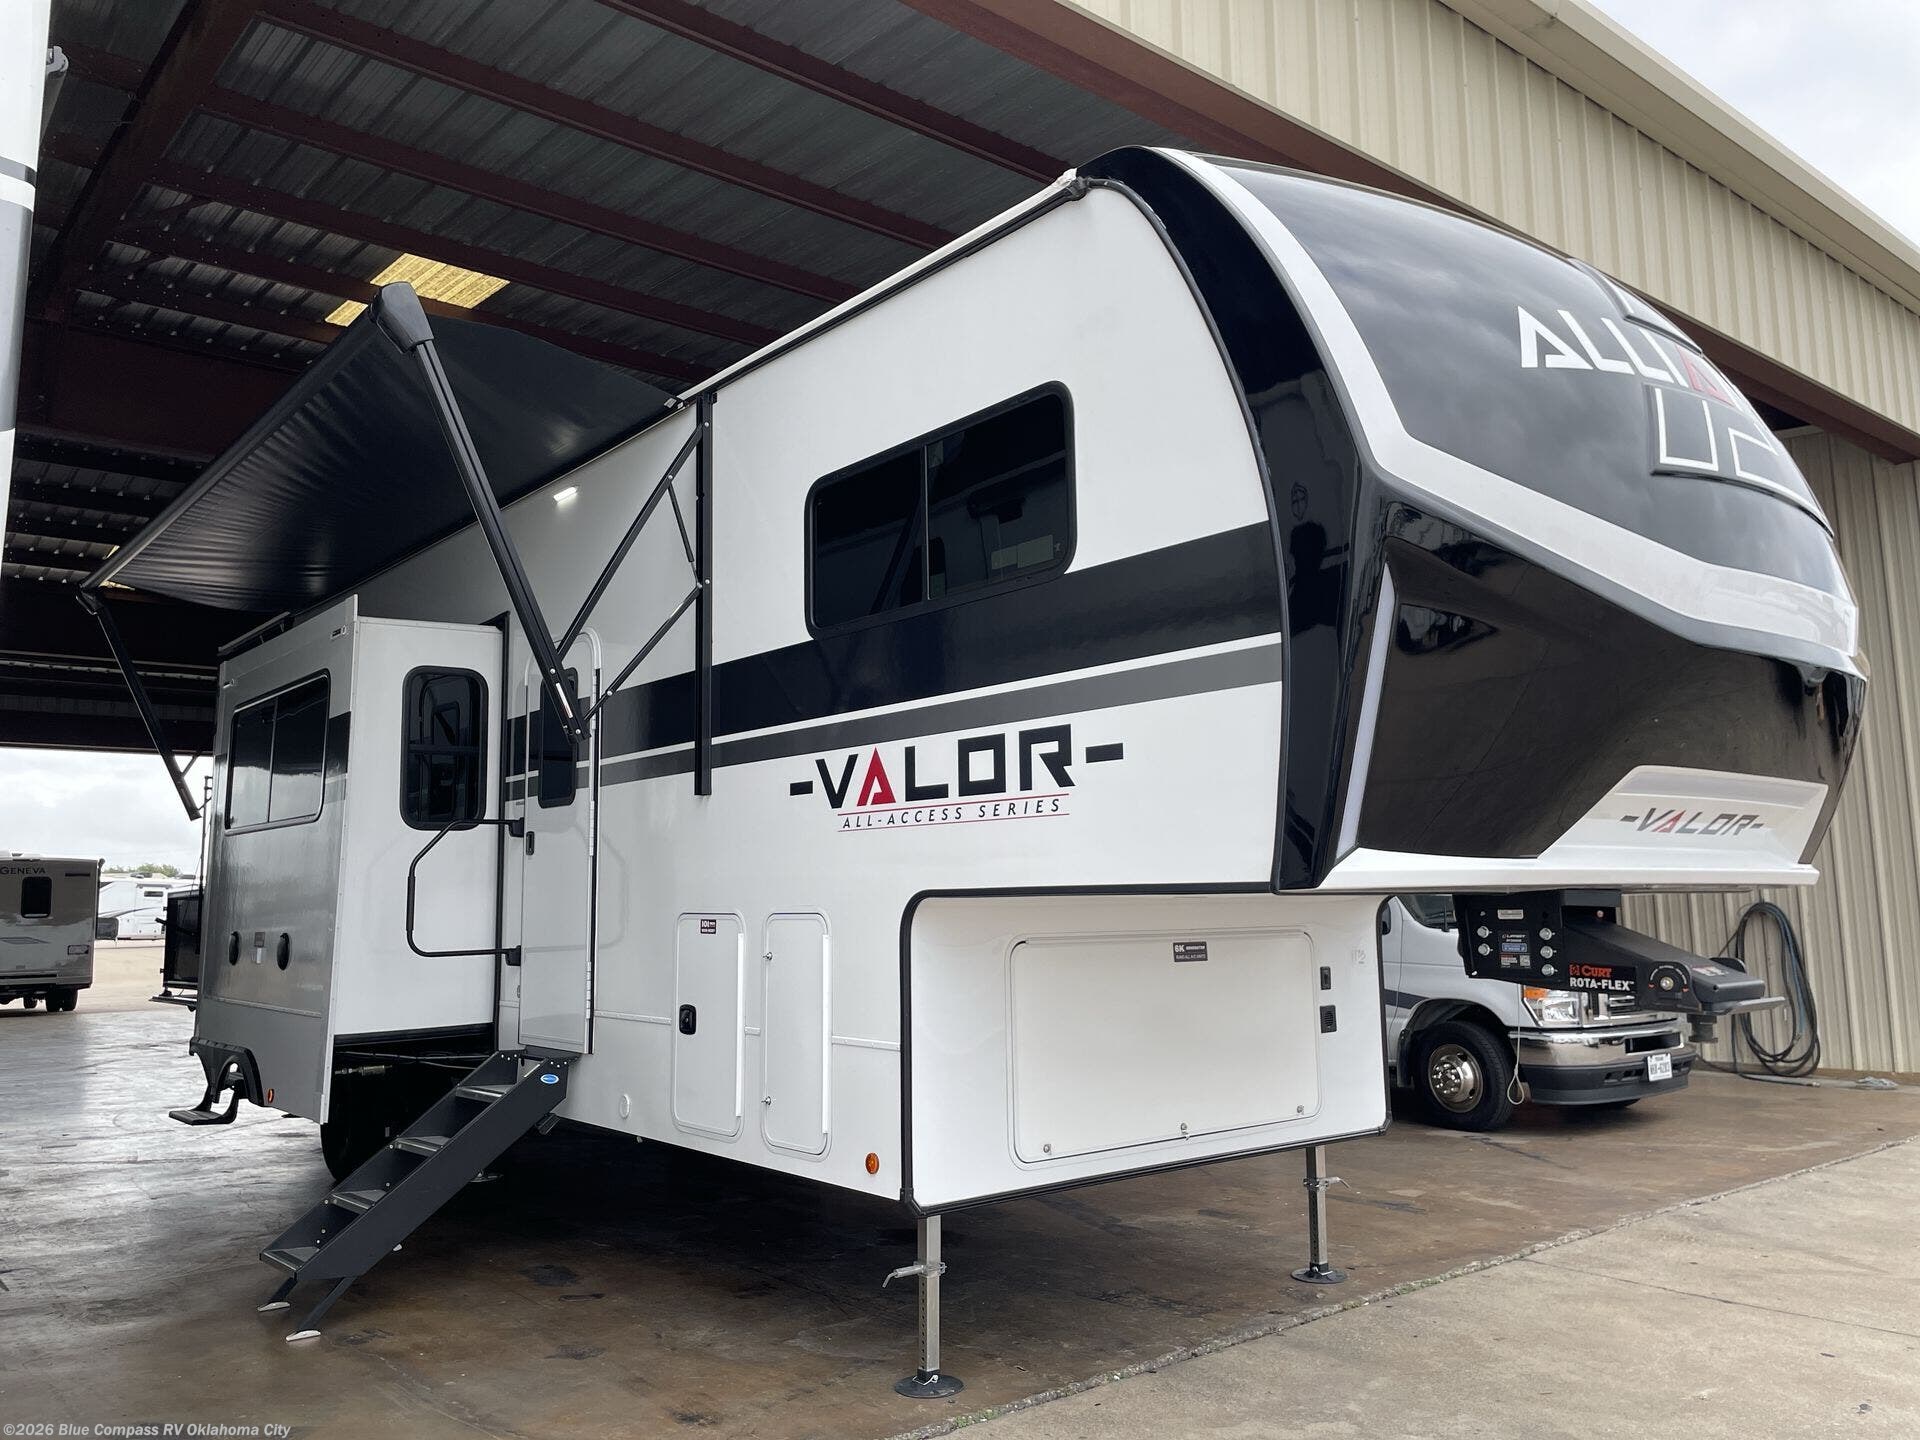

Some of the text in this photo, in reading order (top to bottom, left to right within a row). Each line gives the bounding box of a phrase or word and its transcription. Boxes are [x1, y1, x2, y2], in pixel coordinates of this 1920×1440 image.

[1517, 305, 1745, 412] ALLIA
[842, 798, 1061, 829] ALL-ACCESS SERIES
[0, 866, 46, 875] GENEVA
[1581, 965, 1612, 978] CURT
